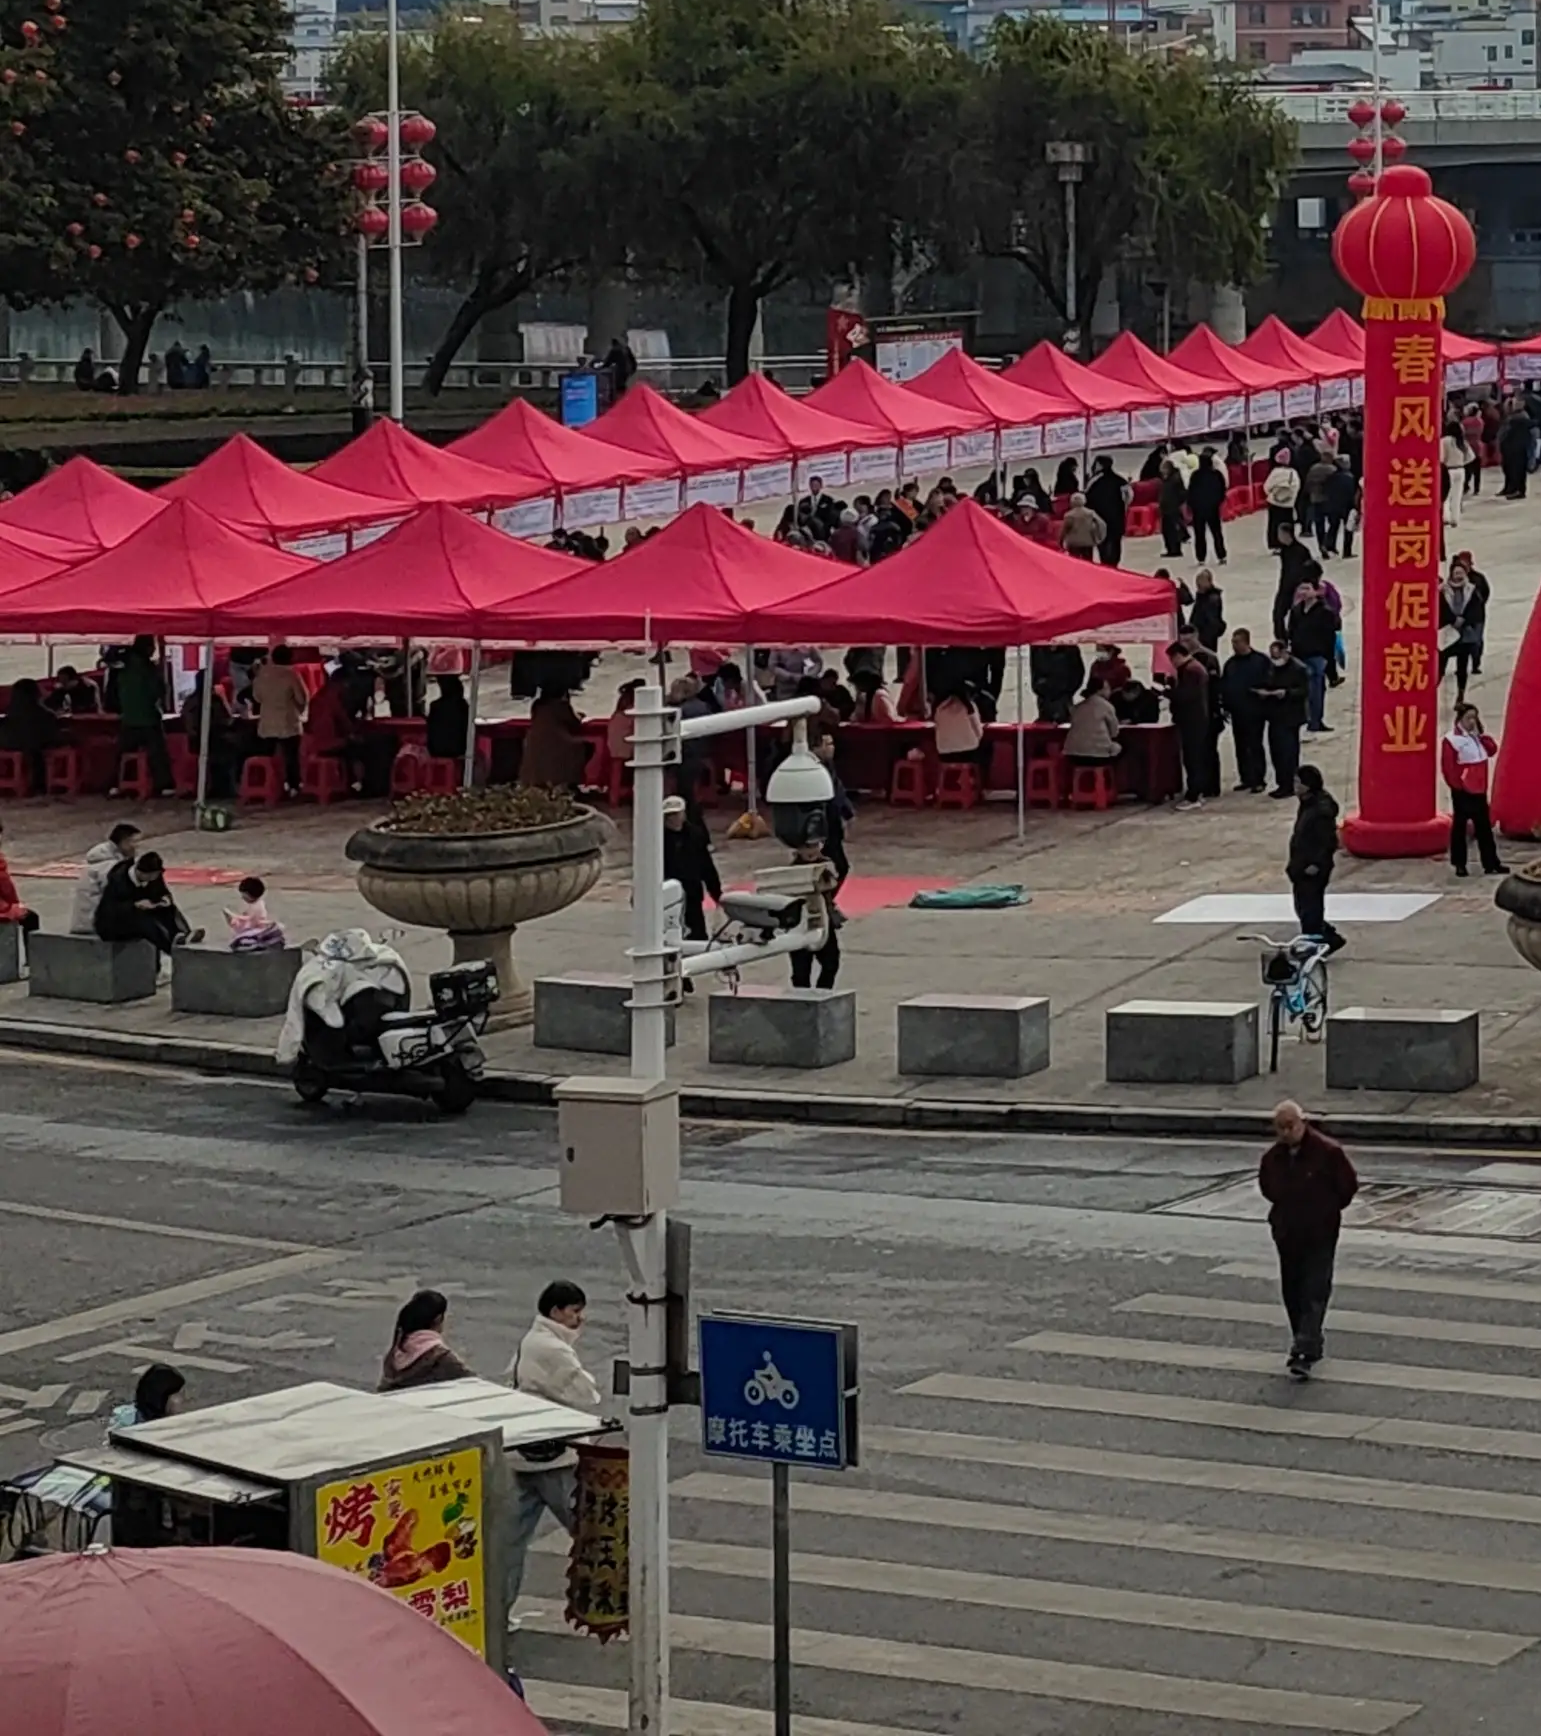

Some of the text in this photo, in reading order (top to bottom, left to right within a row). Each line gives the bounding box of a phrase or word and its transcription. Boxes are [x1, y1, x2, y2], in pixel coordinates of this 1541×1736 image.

[1381, 334, 1436, 754] 春风送岗促就业
[707, 1415, 838, 1459] 摩托车乘坐点
[324, 1482, 381, 1548] 烤
[408, 1579, 470, 1617] 雪梨
